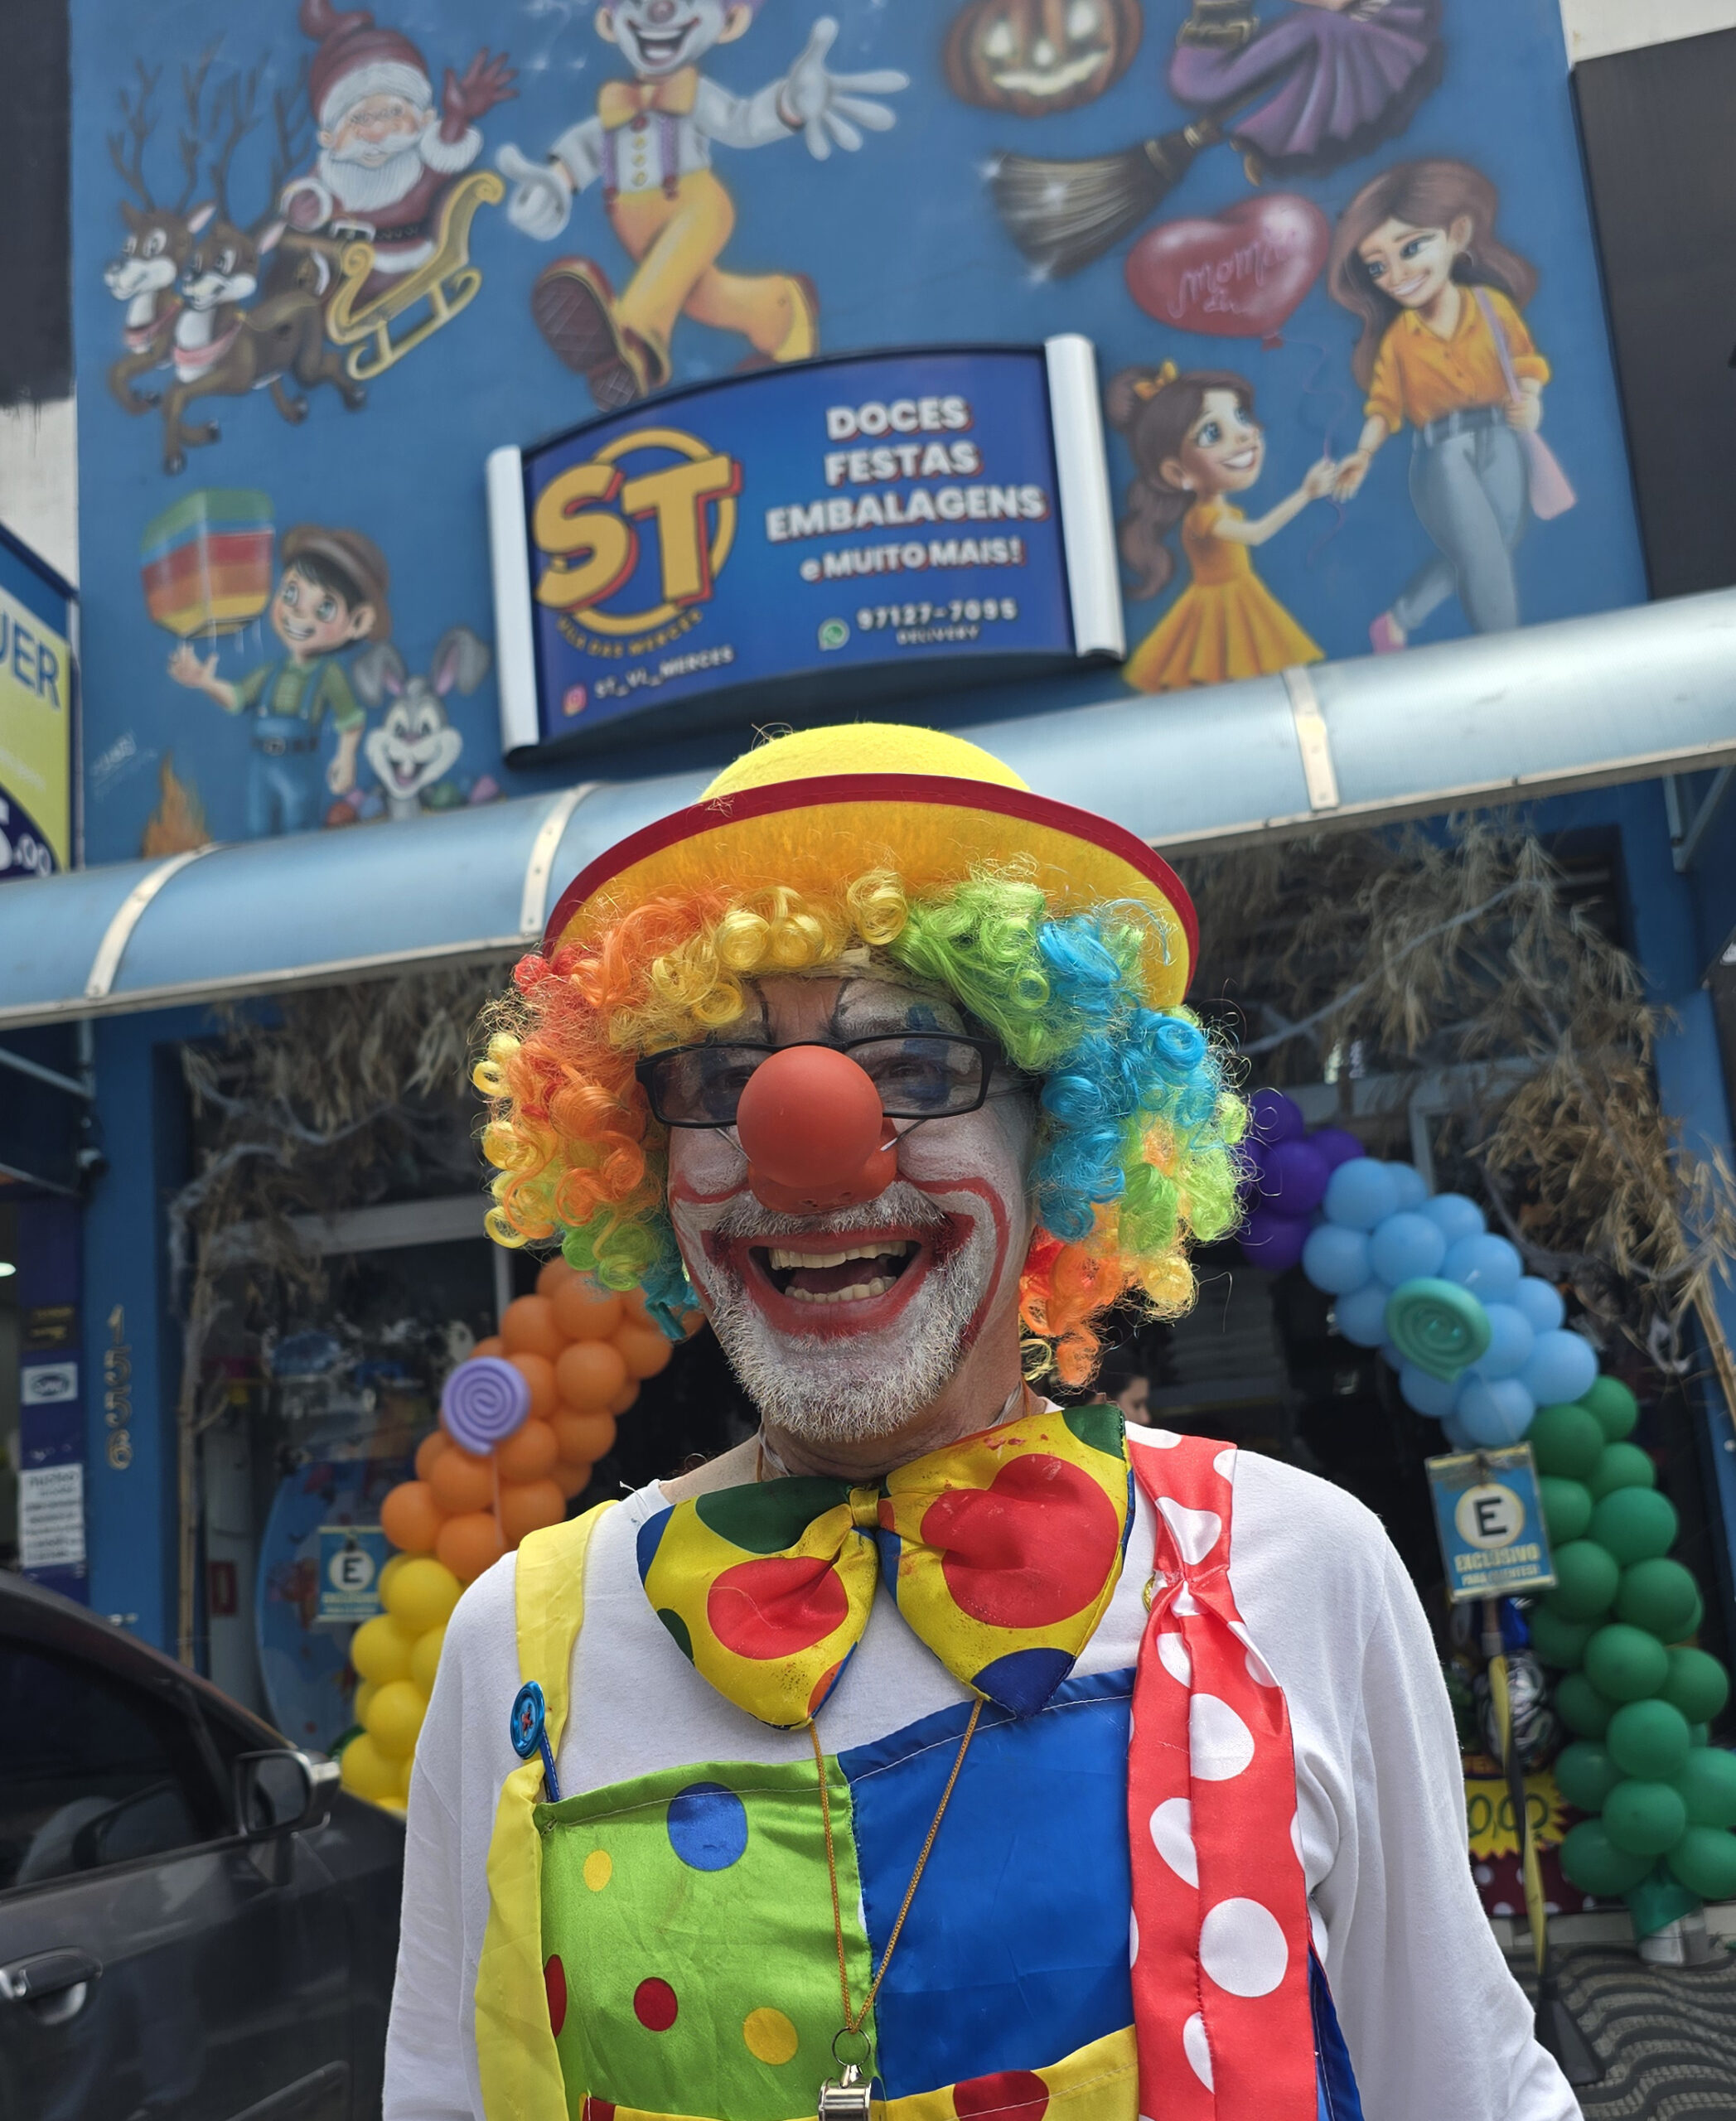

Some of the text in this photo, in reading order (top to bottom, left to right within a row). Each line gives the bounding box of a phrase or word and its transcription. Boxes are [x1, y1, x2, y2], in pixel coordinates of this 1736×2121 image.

[826, 396, 970, 441] DOCES
[824, 441, 981, 486] FESTAS
[532, 452, 742, 611] ST
[766, 484, 1048, 542] EMBALAGENS
[824, 543, 927, 578] MUITO
[928, 536, 1024, 567] MAIS!
[896, 624, 979, 645] DELIVERY
[104, 1303, 133, 1471] 1556
[1473, 1495, 1508, 1538] E
[342, 1557, 365, 1583] E
[1454, 1543, 1541, 1573] EXCLUSIVO
